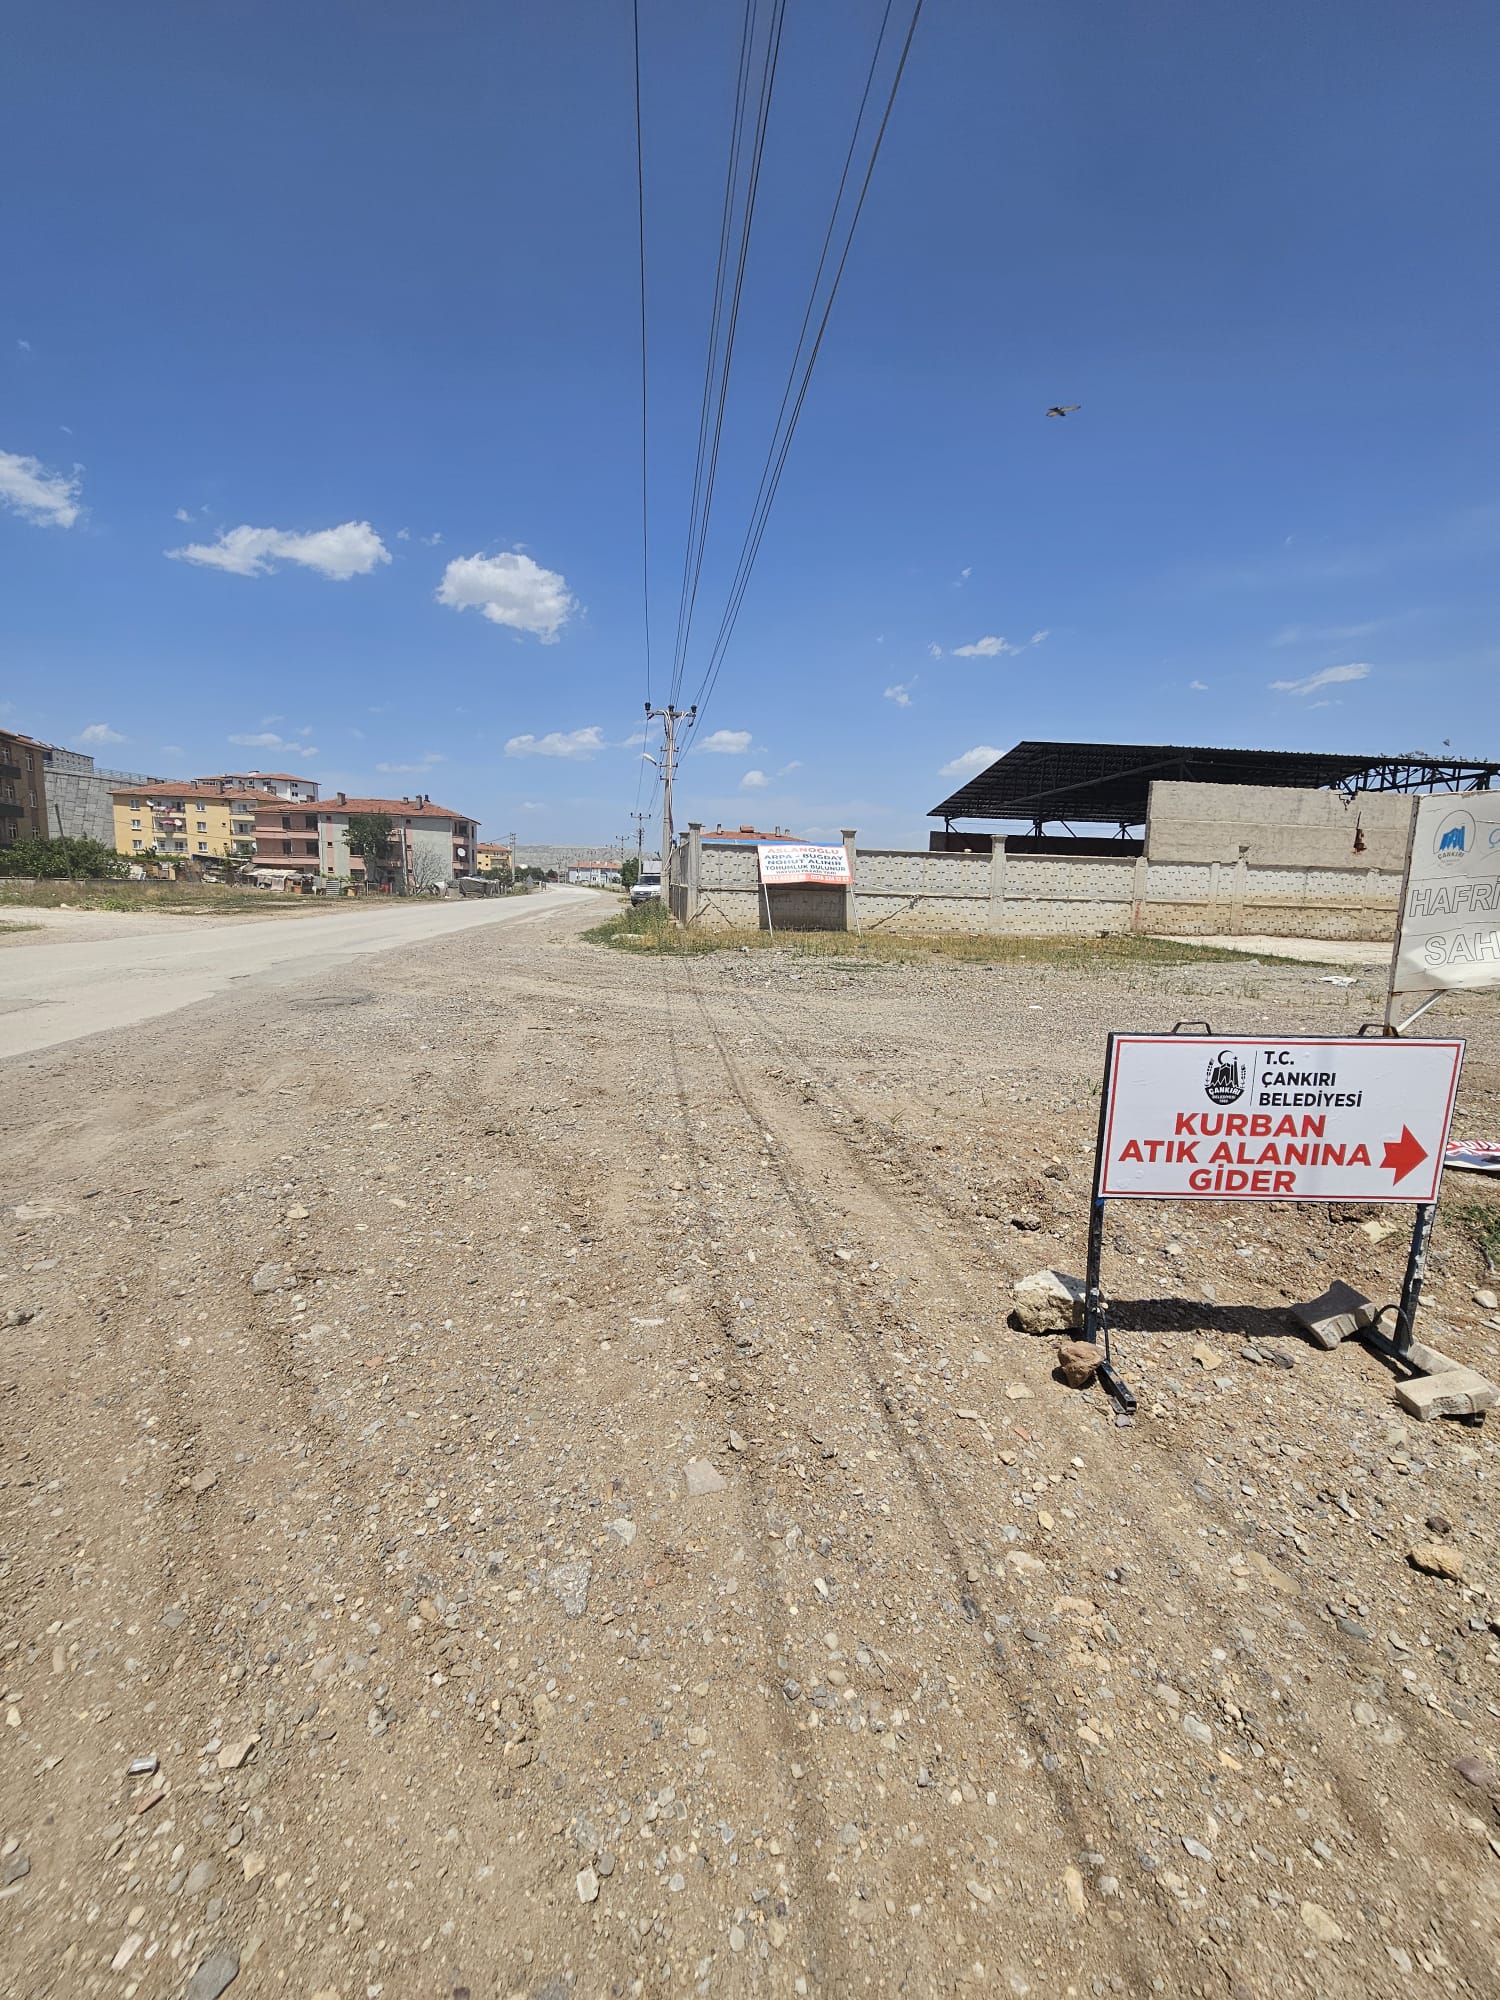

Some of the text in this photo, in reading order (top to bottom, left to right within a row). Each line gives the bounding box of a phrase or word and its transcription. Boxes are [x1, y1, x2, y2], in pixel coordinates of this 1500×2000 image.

[1264, 1050, 1295, 1065] T.C.
[1261, 1072, 1336, 1088] ÇANKIRI
[1208, 1086, 1241, 1096] ÇANKIRI
[1259, 1090, 1363, 1108] BELEDİYESİ
[1174, 1113, 1326, 1138] KURBAN
[1118, 1139, 1372, 1167] ATIK ALANINA
[1188, 1164, 1297, 1193] GİDER
